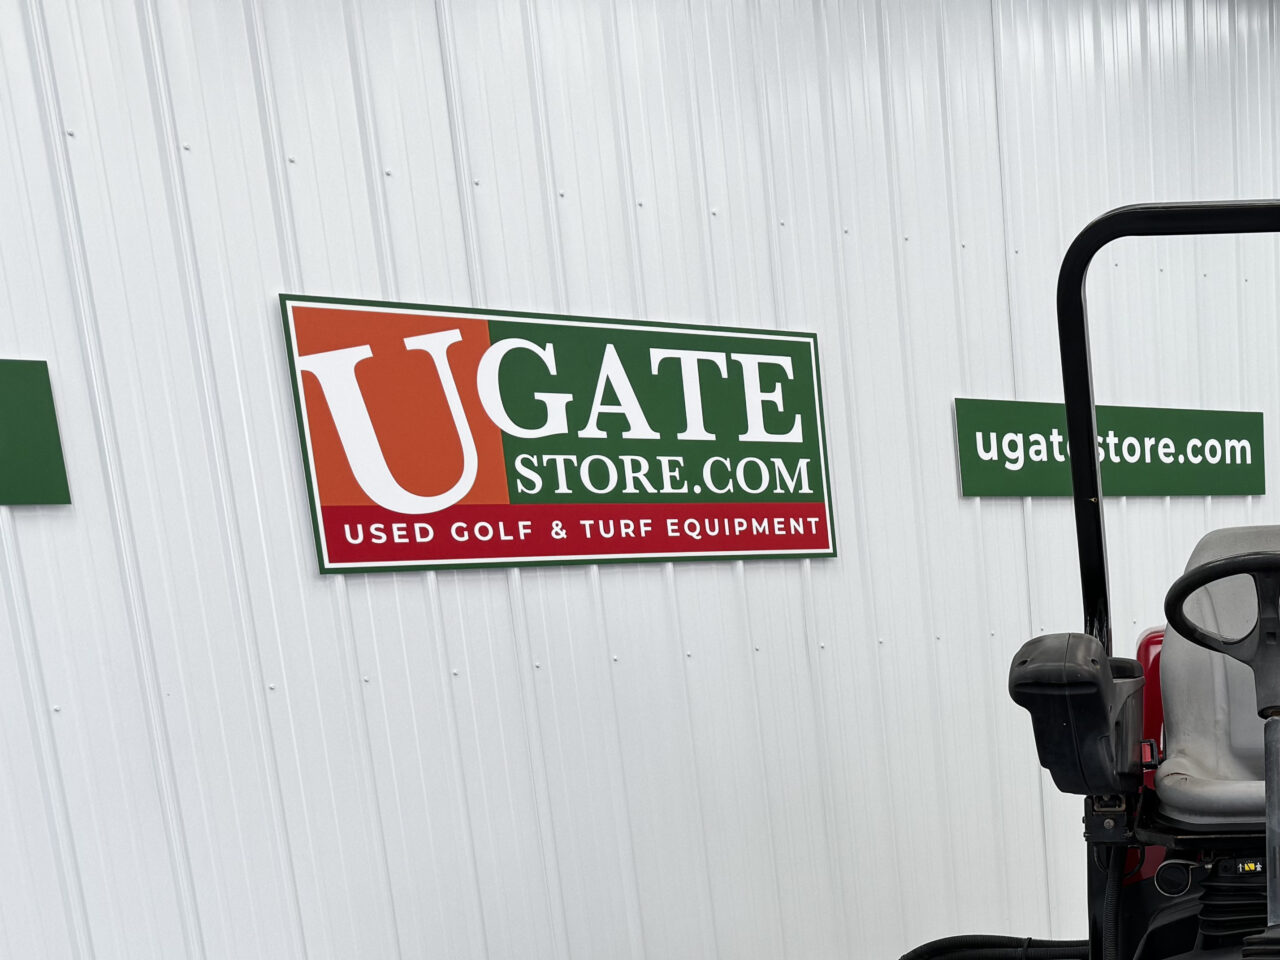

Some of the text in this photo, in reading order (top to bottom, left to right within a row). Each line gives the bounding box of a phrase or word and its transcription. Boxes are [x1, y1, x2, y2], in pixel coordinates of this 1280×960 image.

[298, 328, 804, 515] UGATE
[975, 428, 1252, 471] ugatstore.com
[514, 453, 814, 495] STORE.COM
[344, 517, 820, 545] USED GOLF & TURF EQUIPMENT
